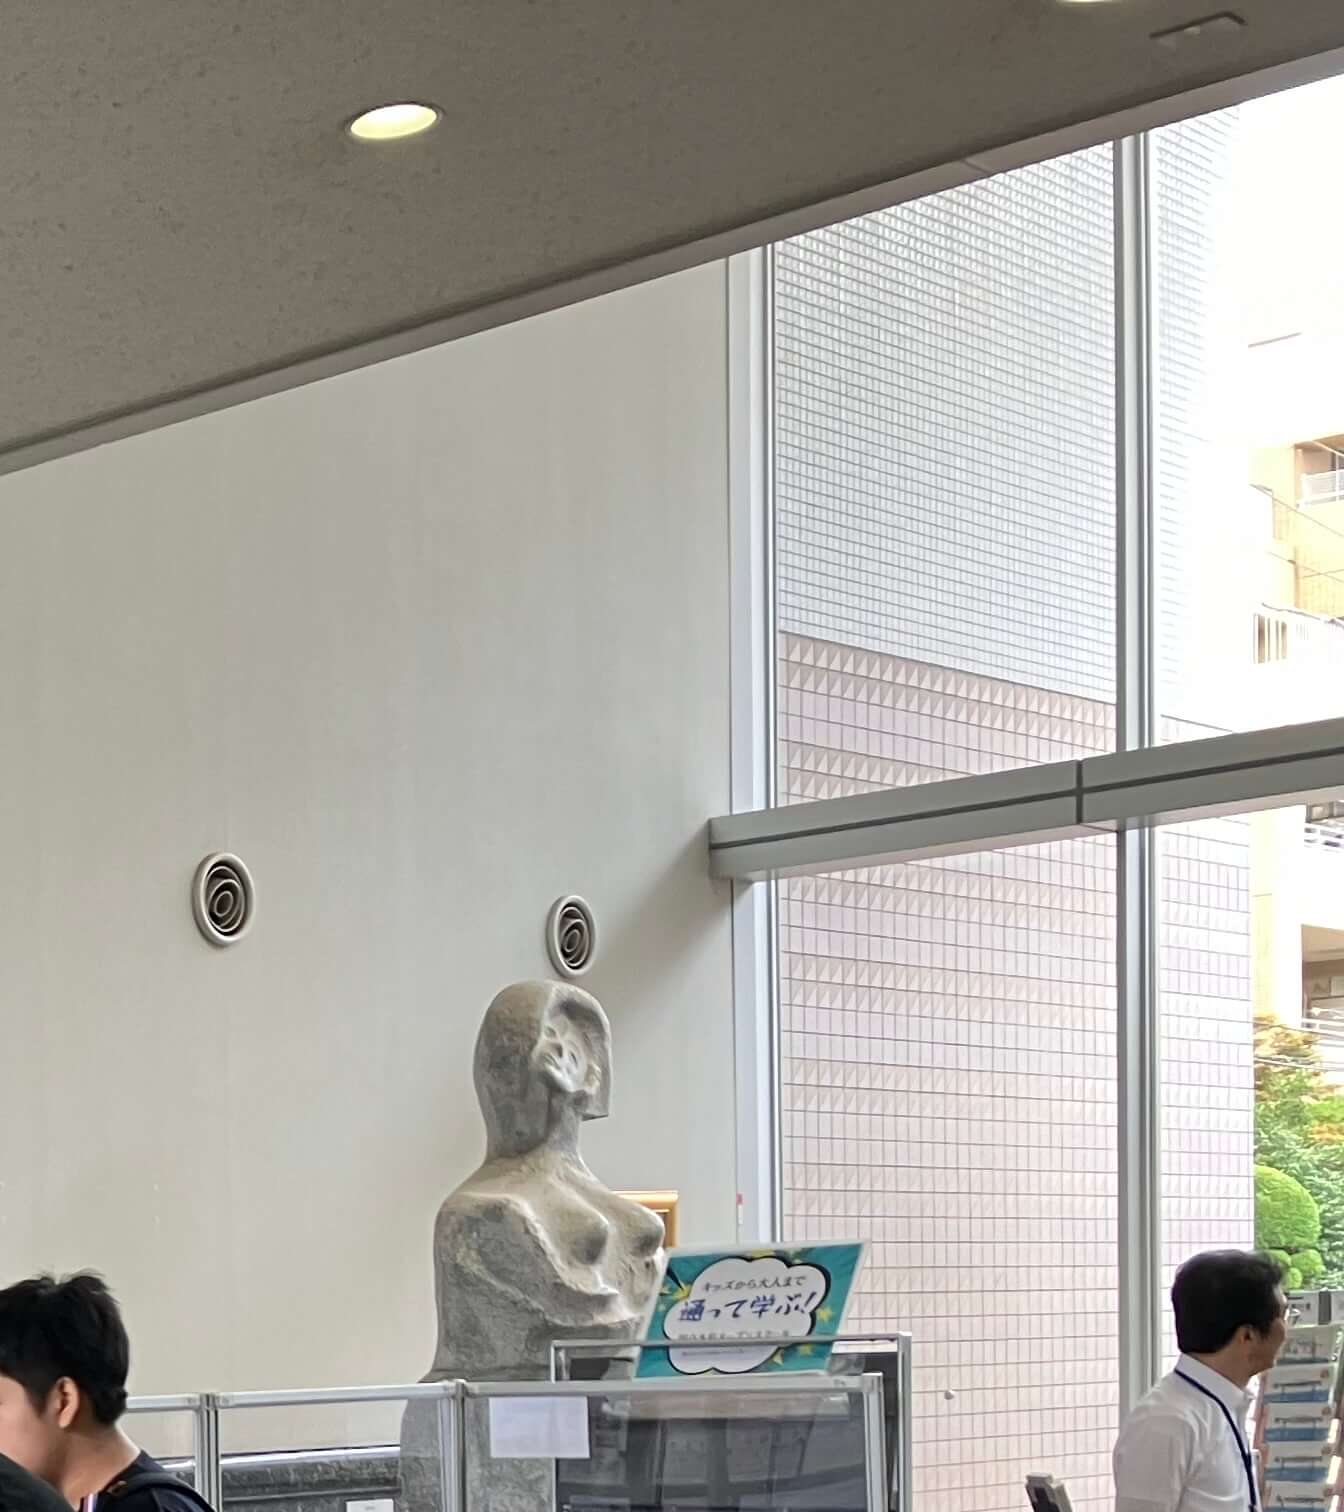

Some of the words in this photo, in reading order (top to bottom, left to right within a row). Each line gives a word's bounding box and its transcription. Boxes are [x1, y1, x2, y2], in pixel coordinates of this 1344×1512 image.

[701, 1275, 807, 1292] キッズから大人まで
[678, 1291, 817, 1322] 通って学ぶ!
